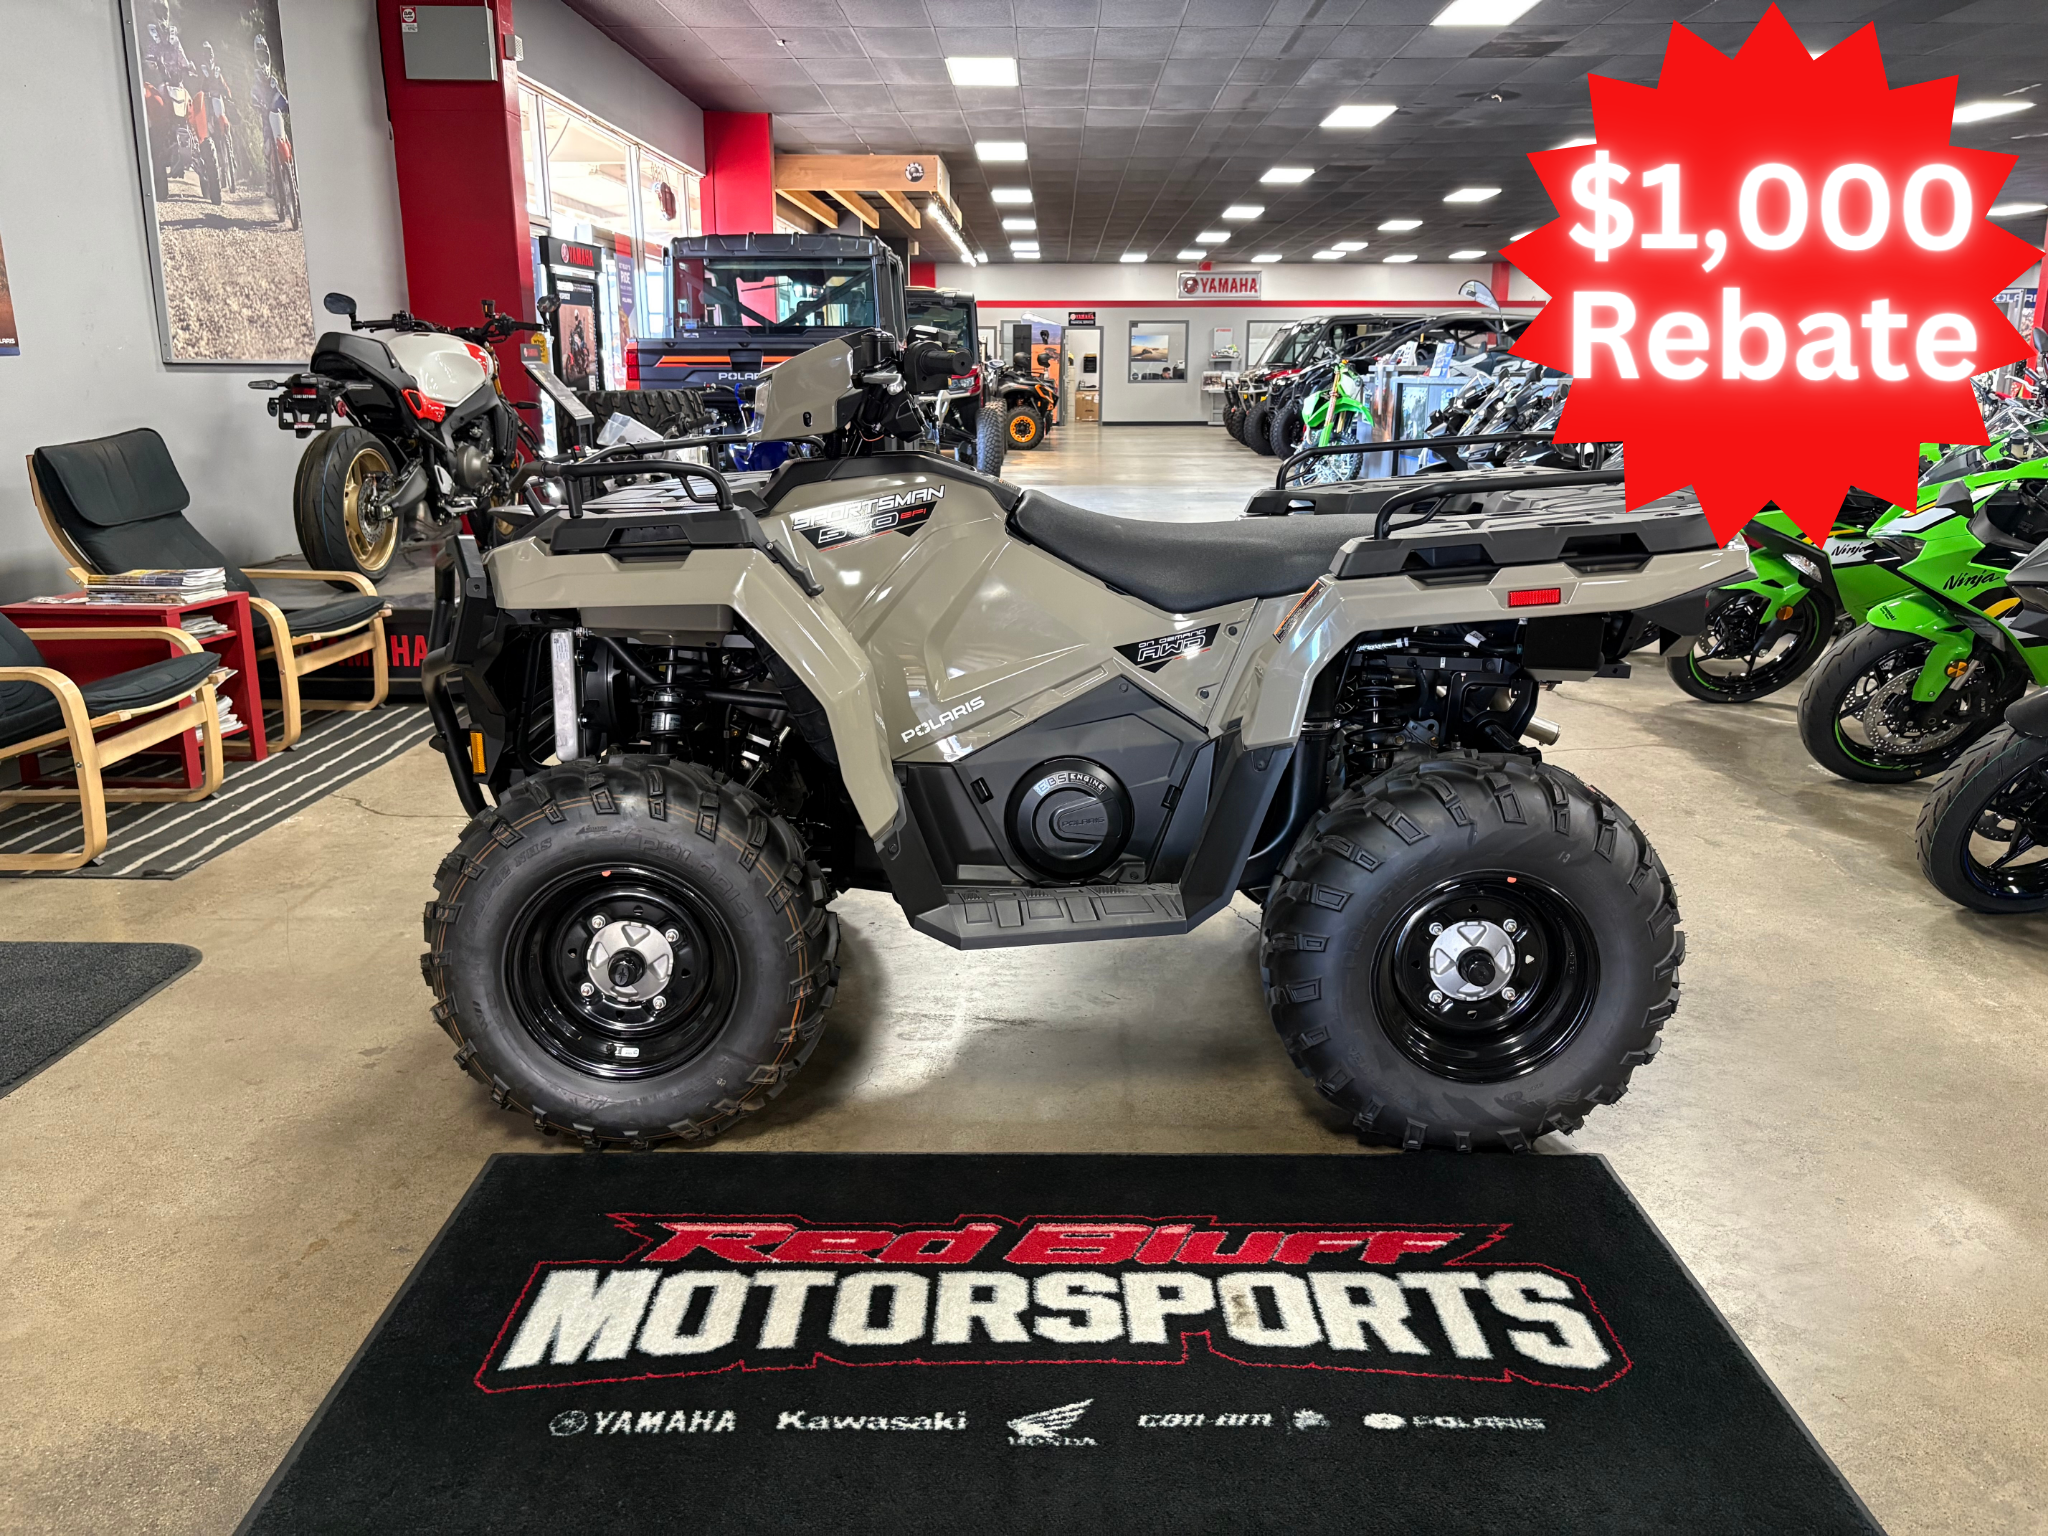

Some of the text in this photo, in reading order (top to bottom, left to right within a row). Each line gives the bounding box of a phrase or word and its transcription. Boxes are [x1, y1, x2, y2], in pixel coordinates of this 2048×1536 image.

[569, 247, 595, 267] YAMAHA
[1200, 277, 1258, 293] YAMAHA
[1995, 294, 2037, 303] OLARI
[791, 485, 945, 531] SPORTSMAN
[900, 508, 927, 519] EFI
[1943, 570, 2001, 592] Ninja
[1137, 635, 1206, 662] AWD
[900, 695, 986, 744] POLARIS
[1037, 774, 1068, 793] EBS
[1069, 773, 1106, 792] ENGINE
[1061, 816, 1106, 828] POLARIS
[638, 835, 754, 919] POLARIS
[641, 1222, 1464, 1265] Red Bluff
[499, 1267, 1611, 1372] MOTORSPORTS
[593, 1409, 738, 1435] YAMAHA
[775, 1410, 969, 1431] Kawasaki
[1412, 1415, 1548, 1431] POLARIS
